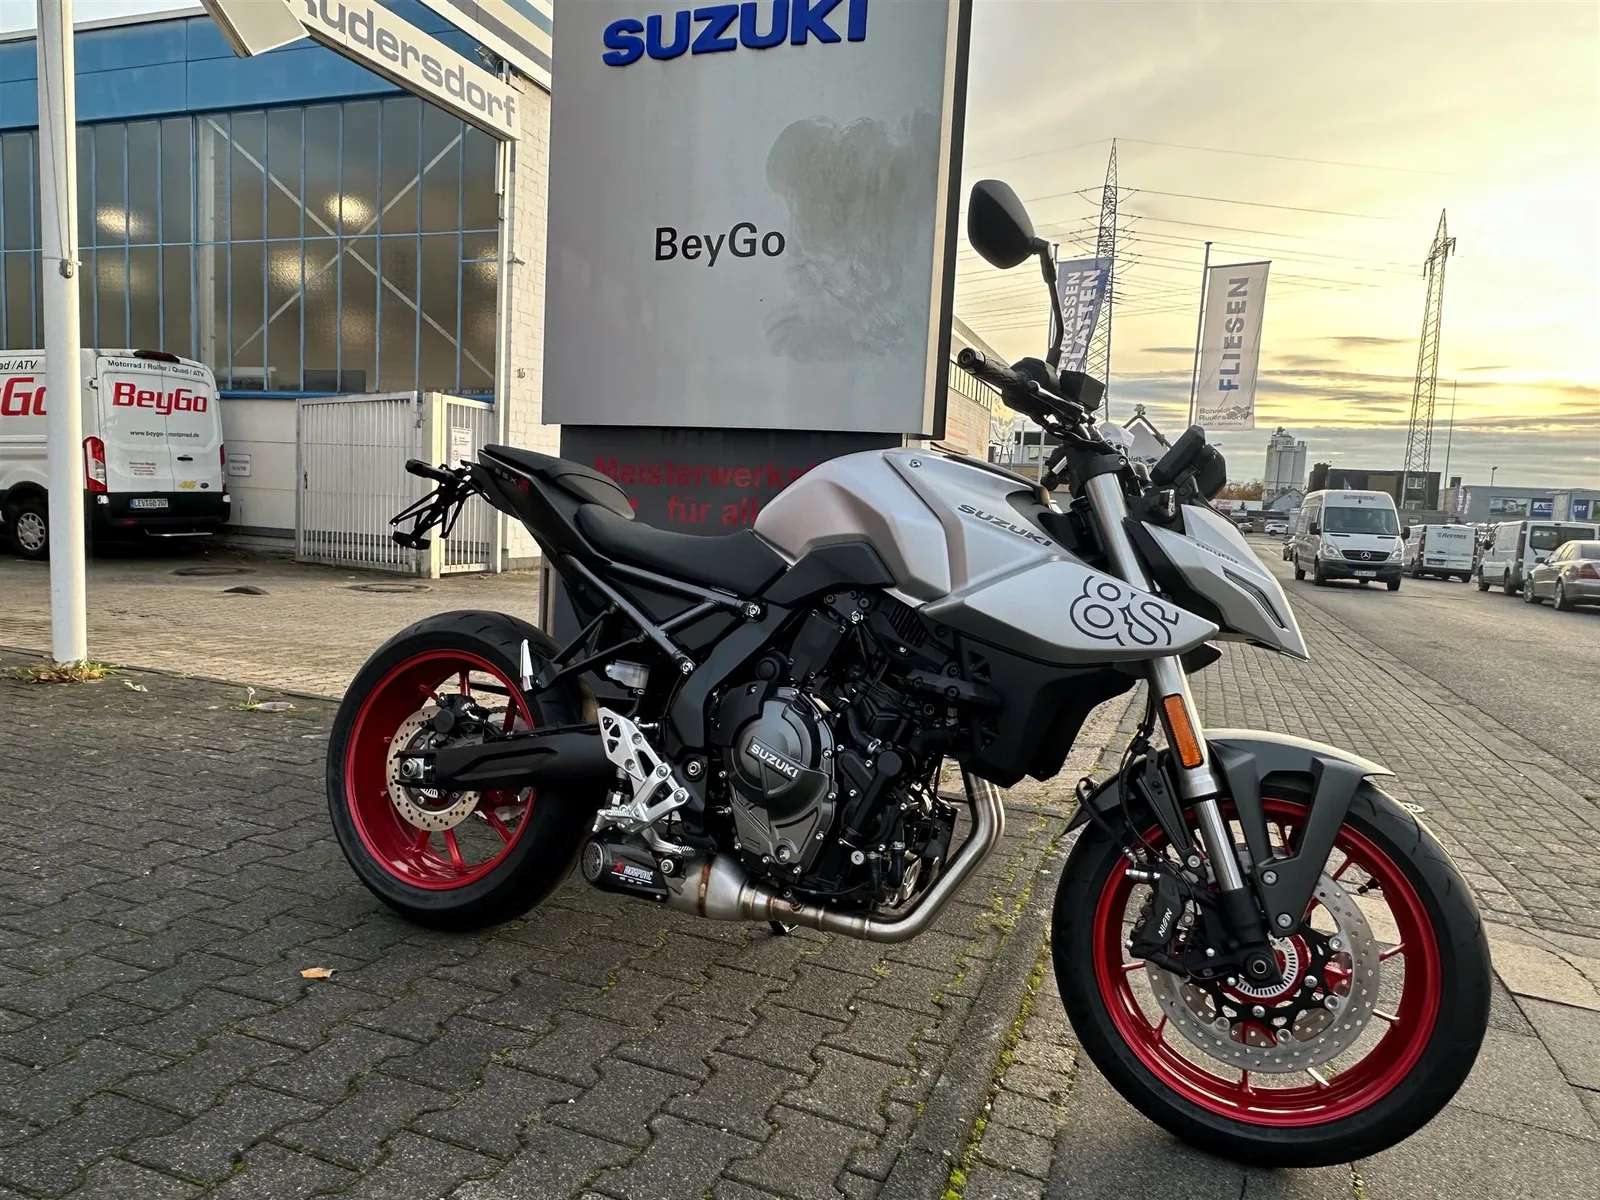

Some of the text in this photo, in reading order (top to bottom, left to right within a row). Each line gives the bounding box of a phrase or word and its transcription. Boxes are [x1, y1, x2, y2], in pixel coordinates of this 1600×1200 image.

[602, 0, 869, 67] SUZUKI
[655, 221, 786, 268] BeyGo
[1218, 276, 1250, 392] FLIESEN
[16, 360, 38, 370] ATV
[107, 360, 142, 369] Motorrad
[147, 363, 167, 371] Roller
[172, 366, 189, 375] Quad
[112, 382, 208, 415] BeyGo
[594, 454, 816, 489] Meisterwerks
[668, 493, 712, 524] für
[957, 504, 1053, 547] SUZUKI
[1441, 532, 1467, 540] Hermes
[750, 743, 799, 778] SUZUKI
[1158, 907, 1173, 938] NISSIN
